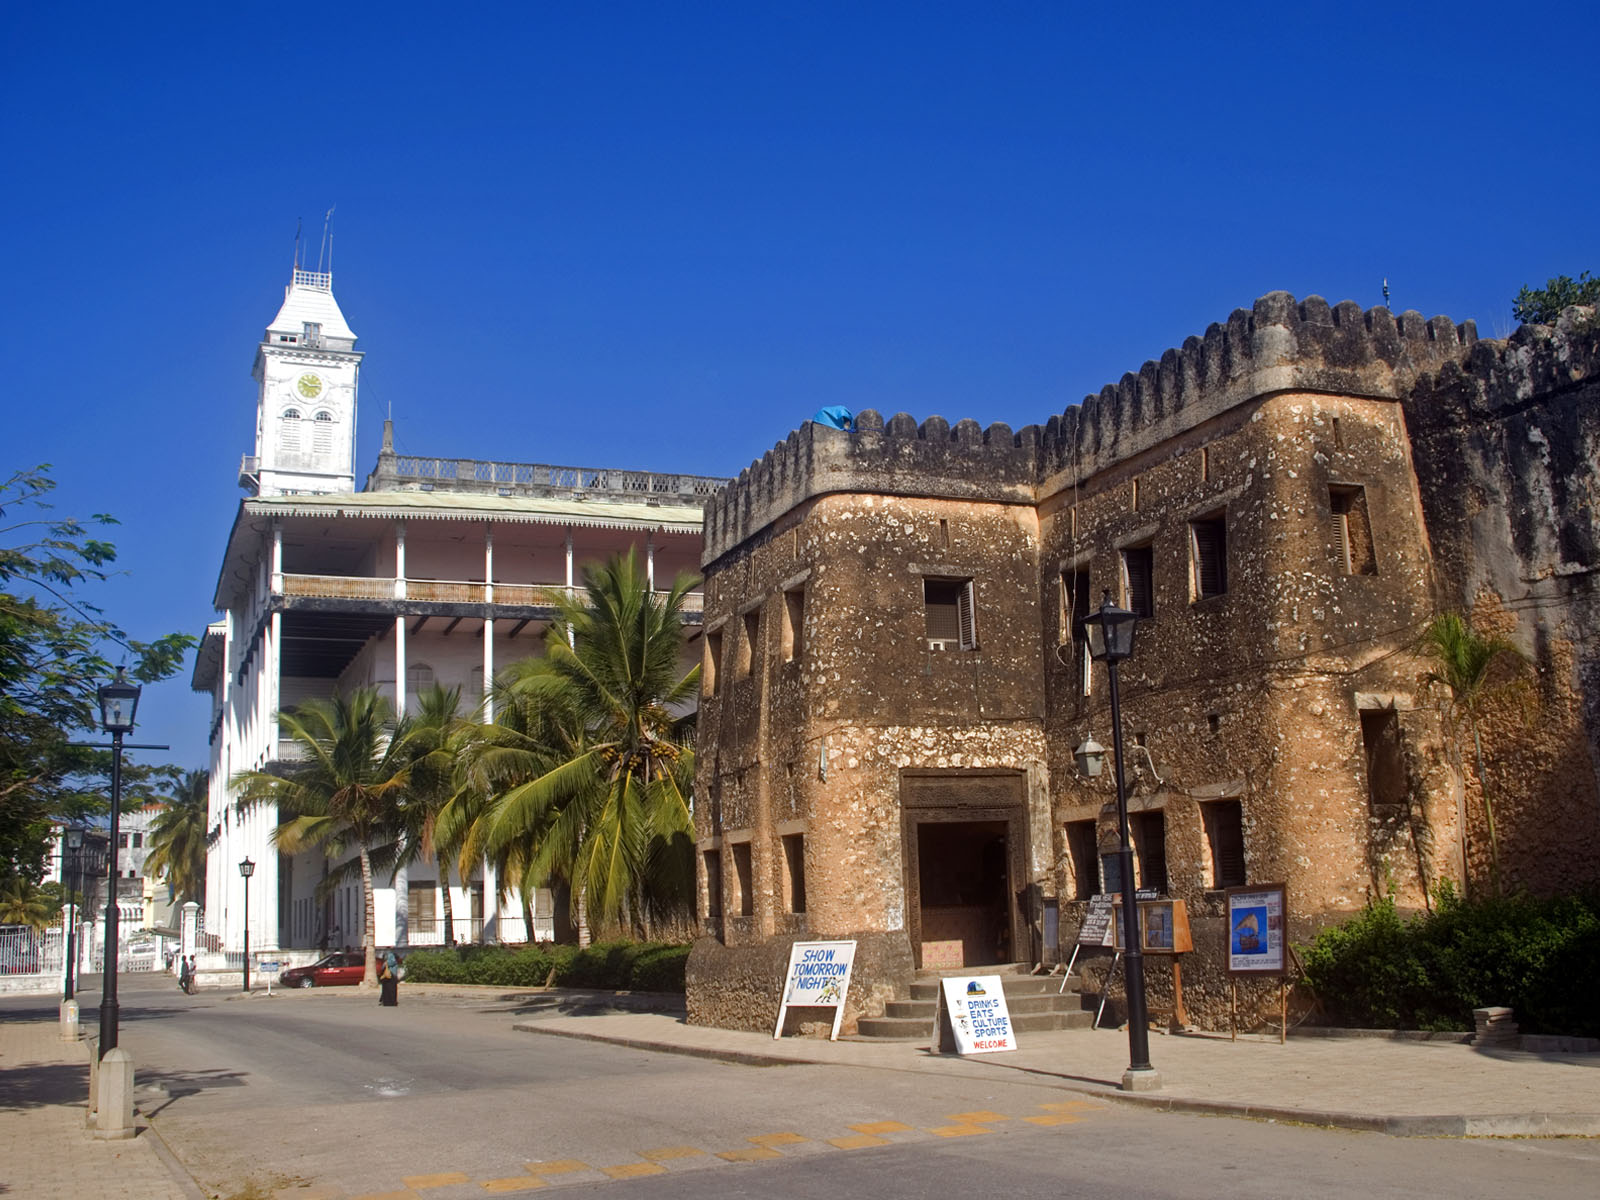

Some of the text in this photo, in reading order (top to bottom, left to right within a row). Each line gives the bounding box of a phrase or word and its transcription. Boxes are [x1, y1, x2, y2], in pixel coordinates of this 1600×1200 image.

[802, 949, 835, 962] SHOW
[794, 963, 847, 976] TOMORROW
[796, 977, 828, 989] NIGHT
[968, 999, 999, 1010] DRINKS
[970, 1009, 994, 1019] EATS
[972, 1017, 1008, 1028] CULTURE
[975, 1026, 1007, 1038] SPORTS
[973, 1039, 1008, 1049] WELCOME
